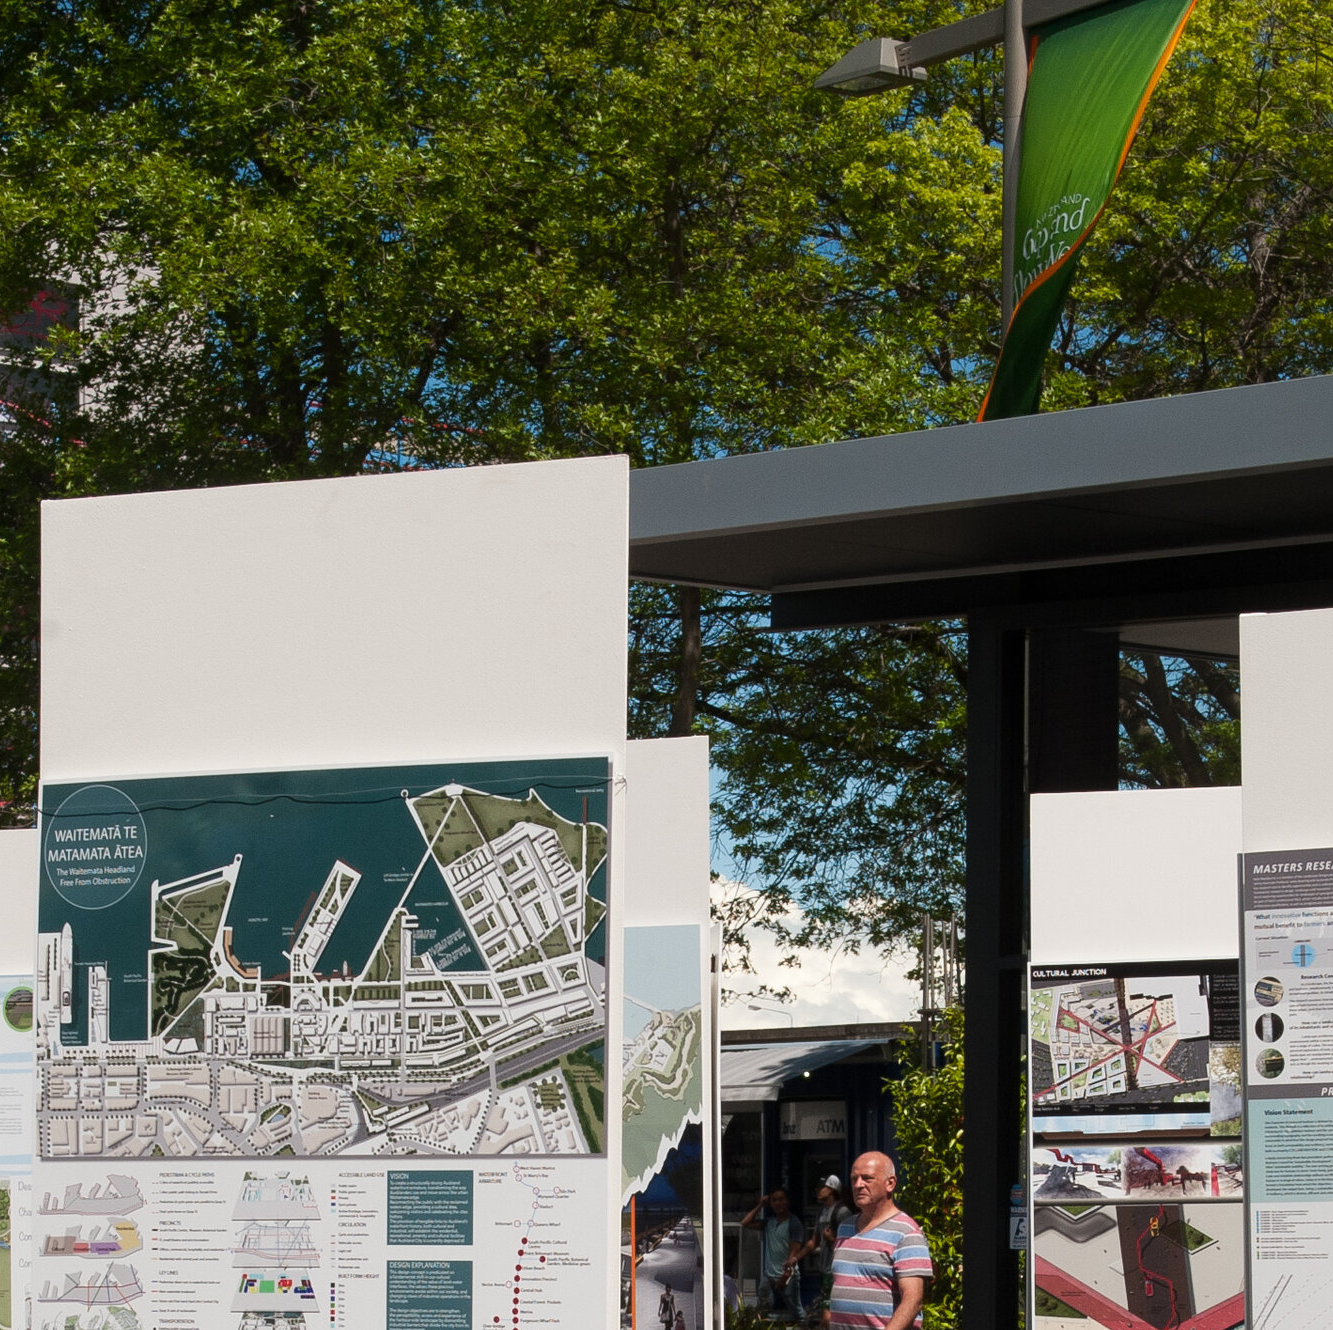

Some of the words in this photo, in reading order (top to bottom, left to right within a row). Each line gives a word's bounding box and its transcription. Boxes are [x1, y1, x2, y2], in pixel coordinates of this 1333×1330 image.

[55, 825, 121, 842] WAITEMATĀ
[124, 826, 137, 839] TE
[48, 847, 111, 862] MATAMATA
[114, 845, 143, 859] ĀTEA
[57, 868, 68, 876] The
[69, 867, 103, 876] Waitemata
[104, 865, 135, 874] Headland
[1253, 861, 1304, 874] MASTERS
[60, 879, 74, 887] Free
[75, 878, 91, 886] From
[93, 877, 131, 886] Obstruction
[1302, 910, 1329, 918] functions
[1032, 969, 1070, 978] CULTURAL
[1071, 968, 1107, 976] JUNCTION
[1282, 1108, 1314, 1116] Statement
[816, 1119, 845, 1134] ATM
[410, 1261, 450, 1269] EXPLANATION
